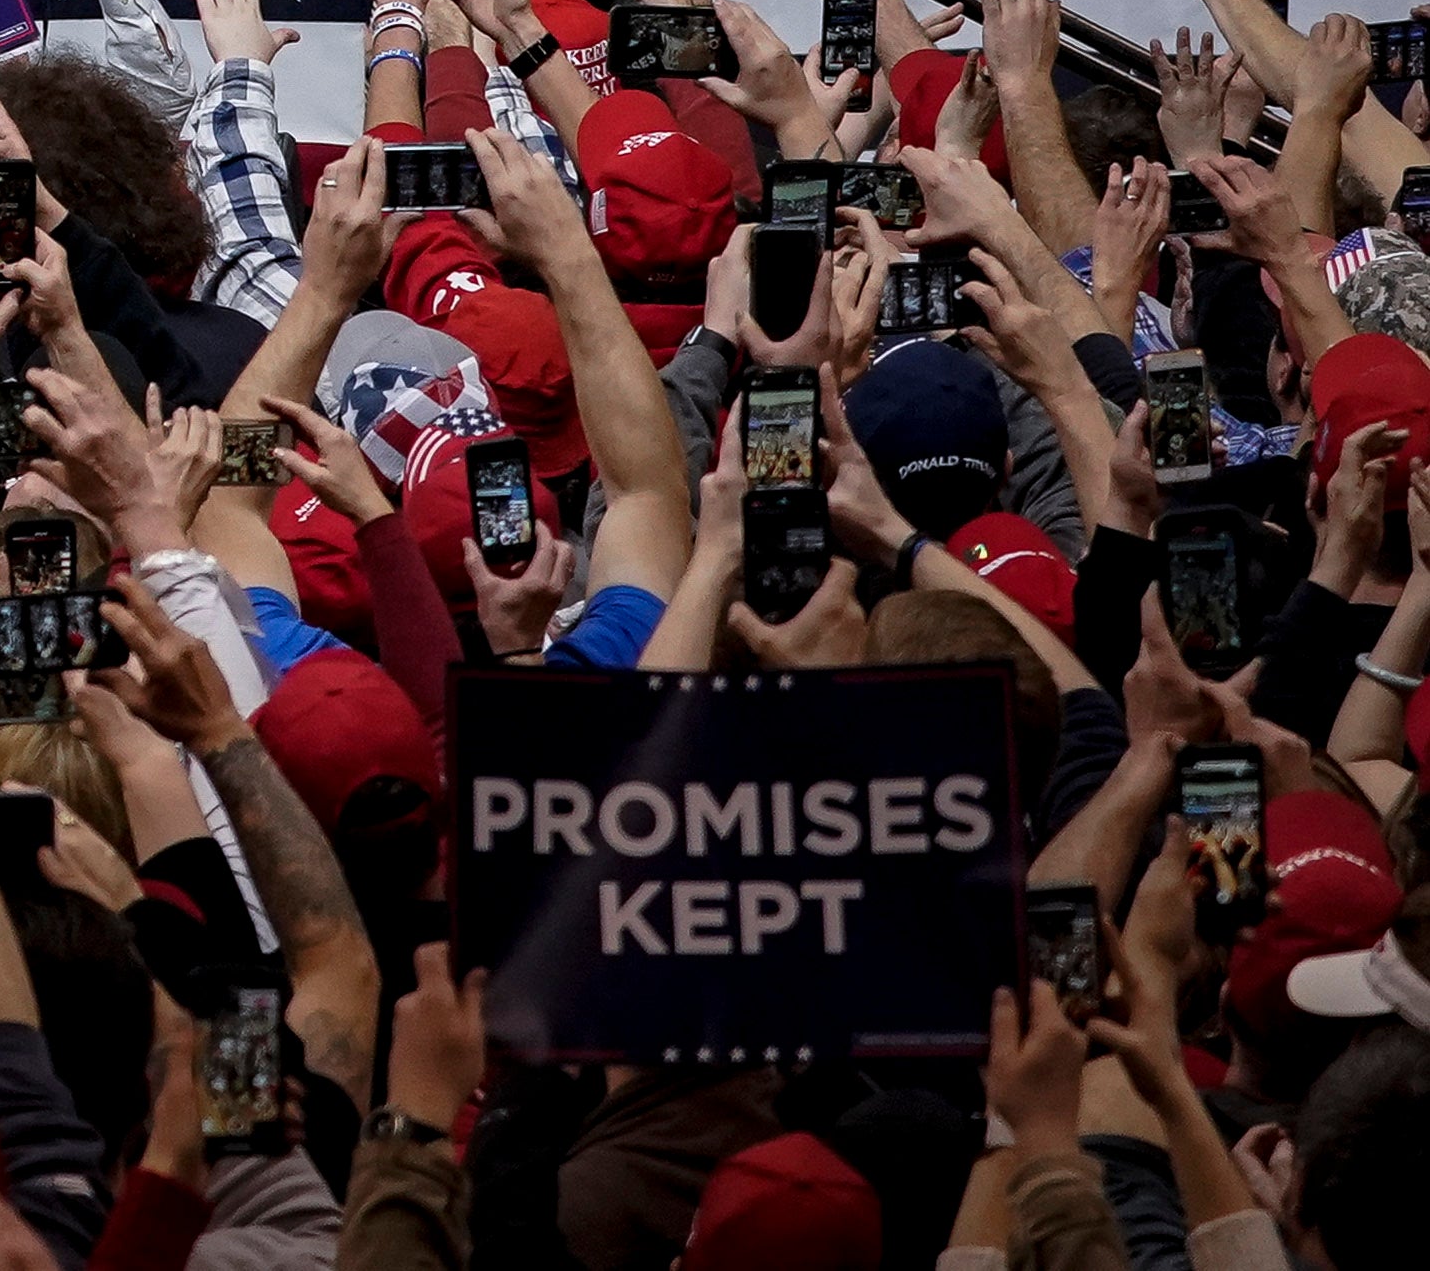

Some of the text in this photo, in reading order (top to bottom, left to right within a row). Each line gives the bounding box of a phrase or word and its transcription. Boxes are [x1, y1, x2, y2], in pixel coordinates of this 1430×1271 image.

[899, 454, 960, 480] DONALD
[471, 775, 995, 858] PROMISES
[597, 879, 865, 957] KEPT
